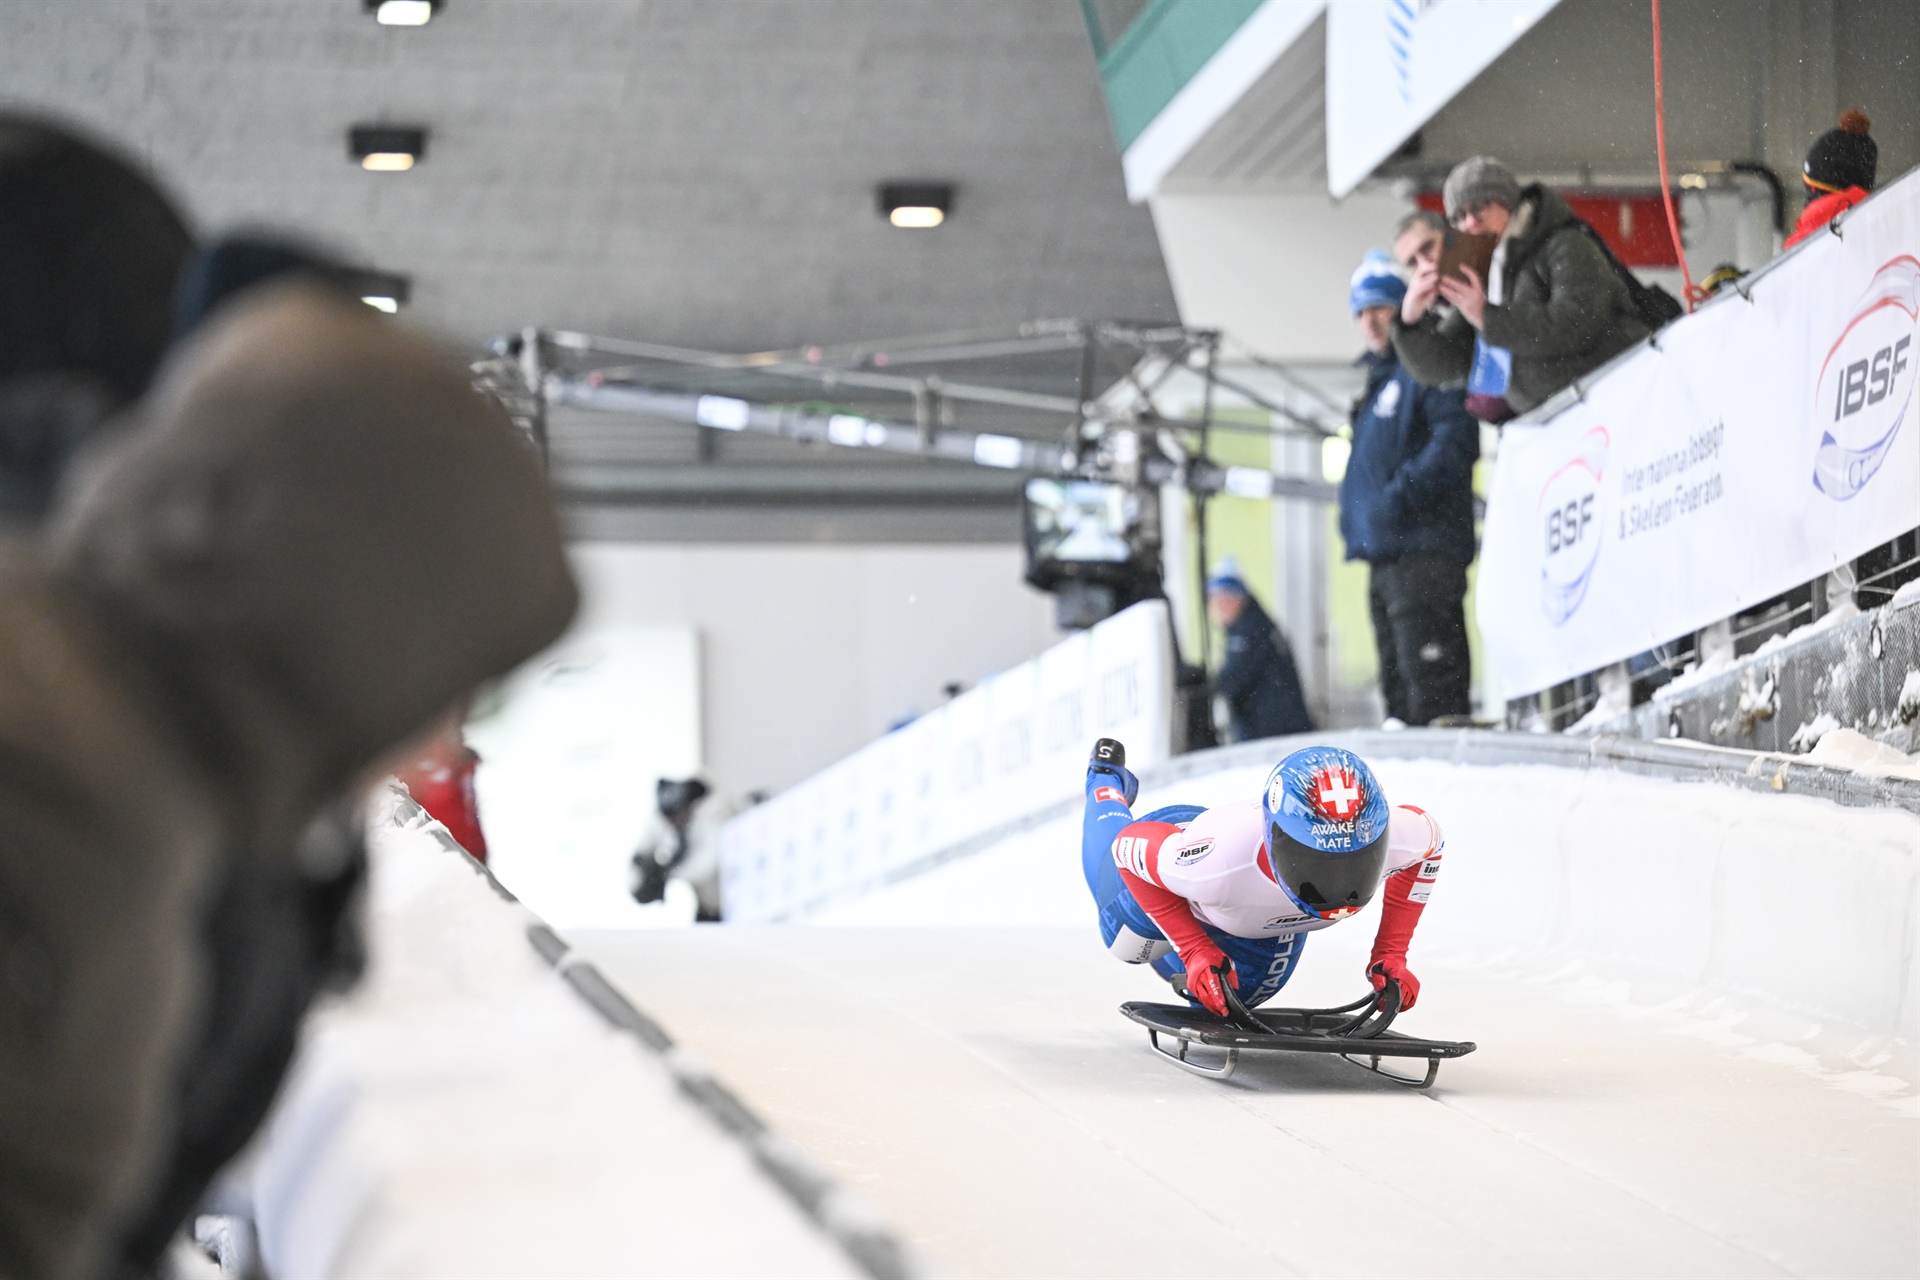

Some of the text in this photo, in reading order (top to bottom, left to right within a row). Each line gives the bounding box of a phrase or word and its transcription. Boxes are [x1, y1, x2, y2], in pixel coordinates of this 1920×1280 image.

[1834, 332, 1912, 423] IBSF
[1544, 492, 1595, 560] IBSF
[1310, 821, 1355, 837] AWAKE
[1180, 844, 1210, 858] IBSF
[1316, 836, 1352, 849] MATE
[1136, 939, 1155, 961] Celerina
